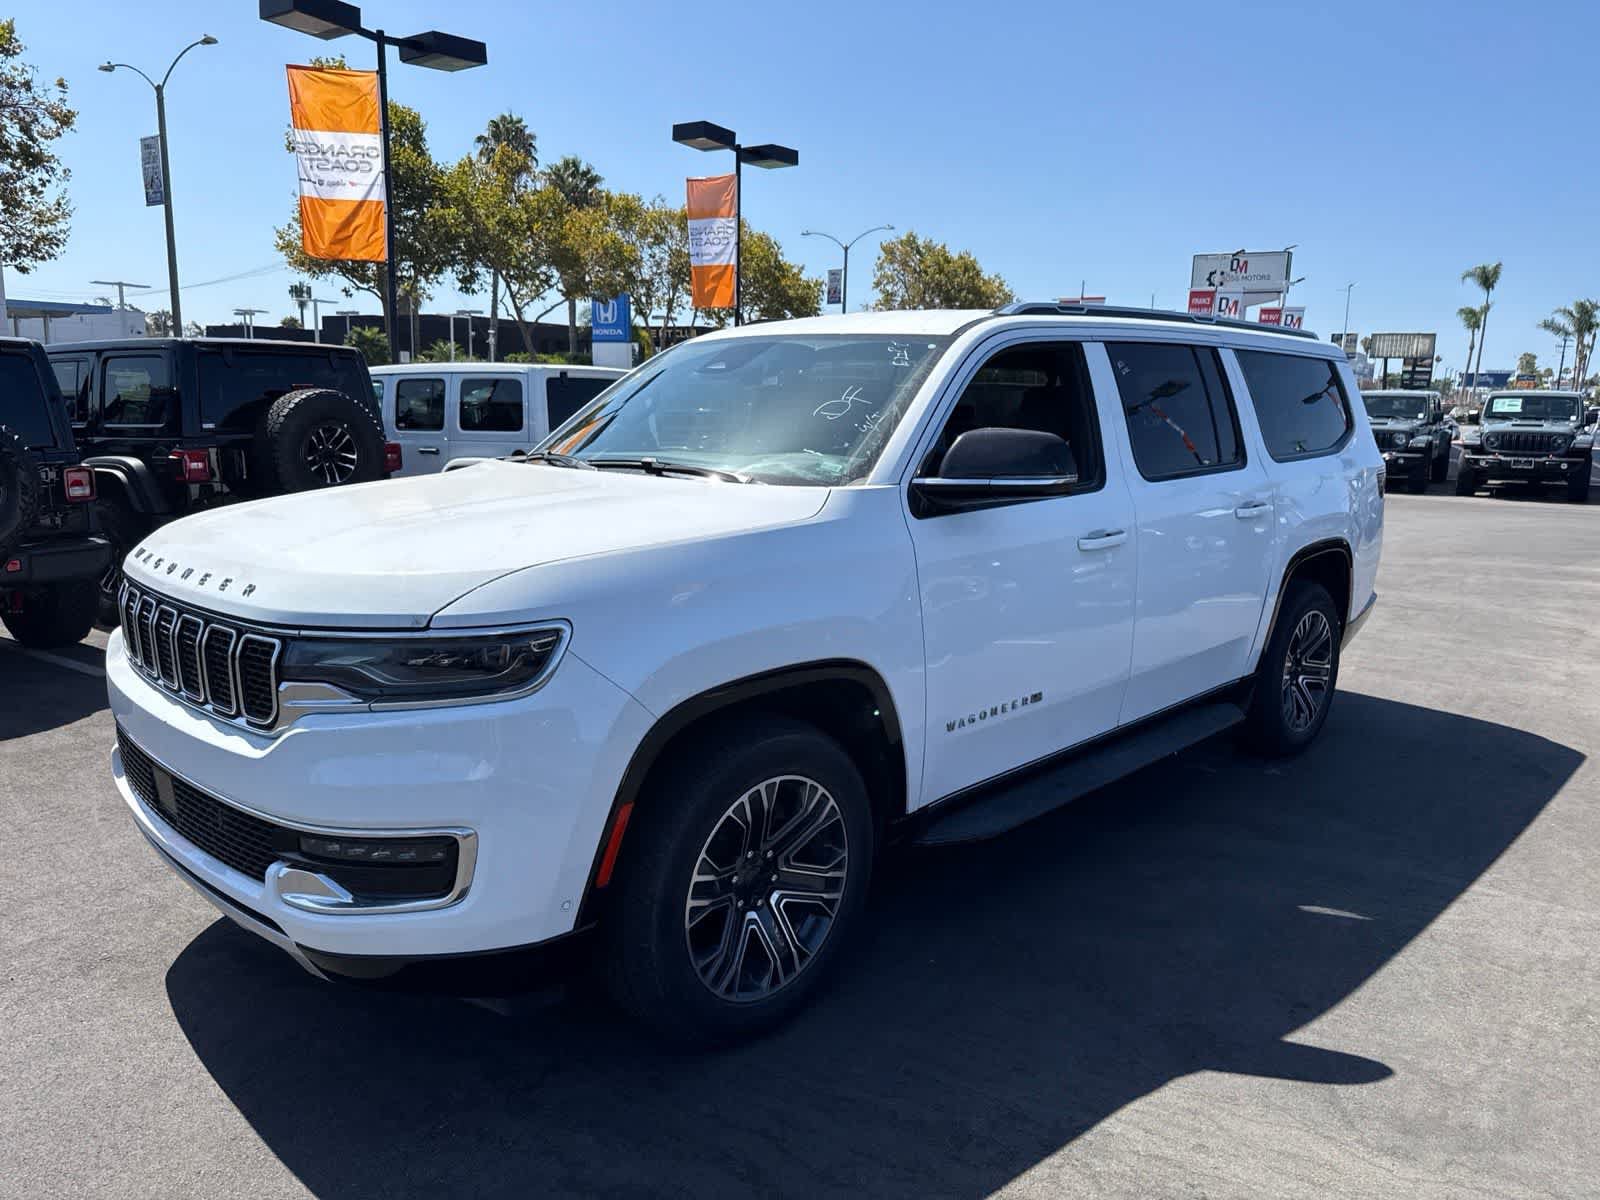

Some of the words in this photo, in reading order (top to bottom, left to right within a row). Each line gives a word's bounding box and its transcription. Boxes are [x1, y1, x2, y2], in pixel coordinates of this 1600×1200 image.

[592, 328, 623, 336] HONDA
[134, 547, 257, 598] WAGONEER
[945, 696, 1029, 733] WAGONEER
